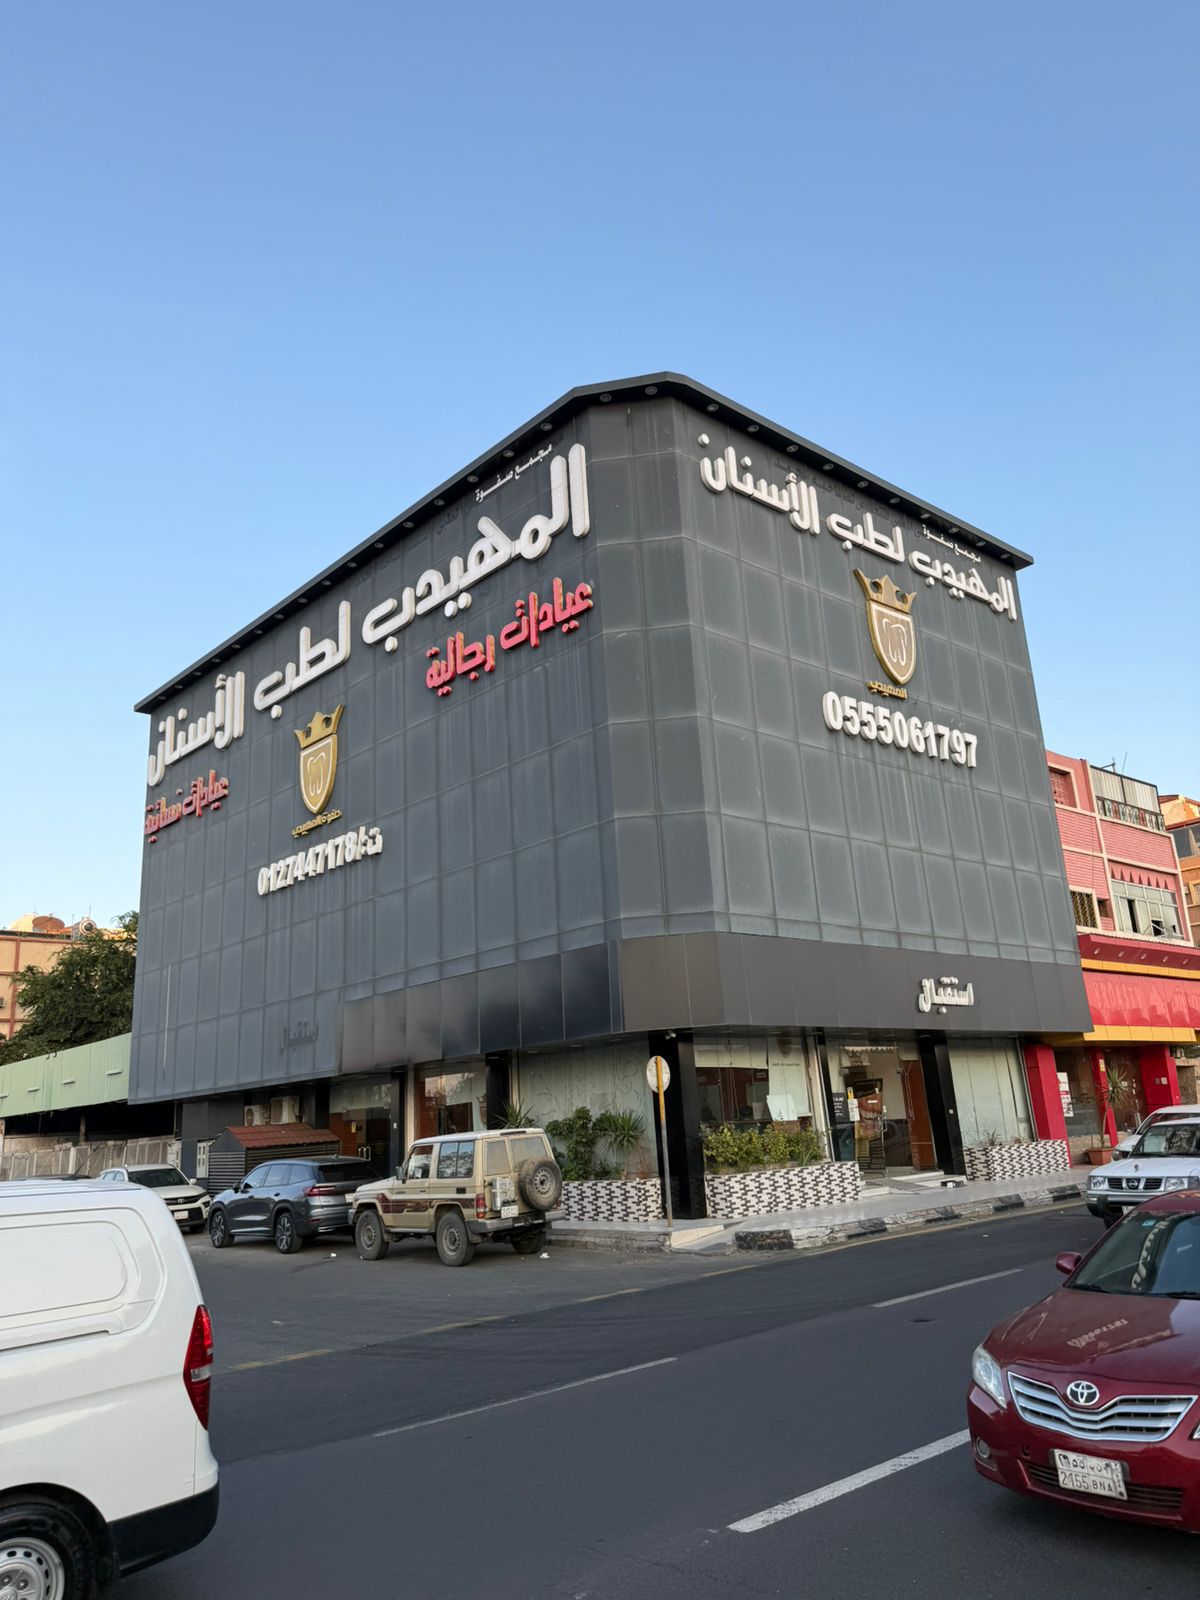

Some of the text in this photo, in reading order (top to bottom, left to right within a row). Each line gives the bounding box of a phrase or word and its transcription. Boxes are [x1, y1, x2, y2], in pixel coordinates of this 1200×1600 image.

[475, 443, 552, 503] مجمع صفوة
[698, 433, 820, 536] الأسنان
[826, 512, 905, 563] لطب
[922, 524, 954, 549] صفوة
[148, 443, 590, 787] المهيدب لطب الأسنان
[908, 550, 1017, 621] المهيدب
[425, 577, 593, 697] عيادات رجالية
[822, 691, 977, 768] 0555061797
[182, 769, 229, 817] عيادات
[919, 976, 974, 1014] استقبال
[1092, 1479, 1113, 1493] BNA
